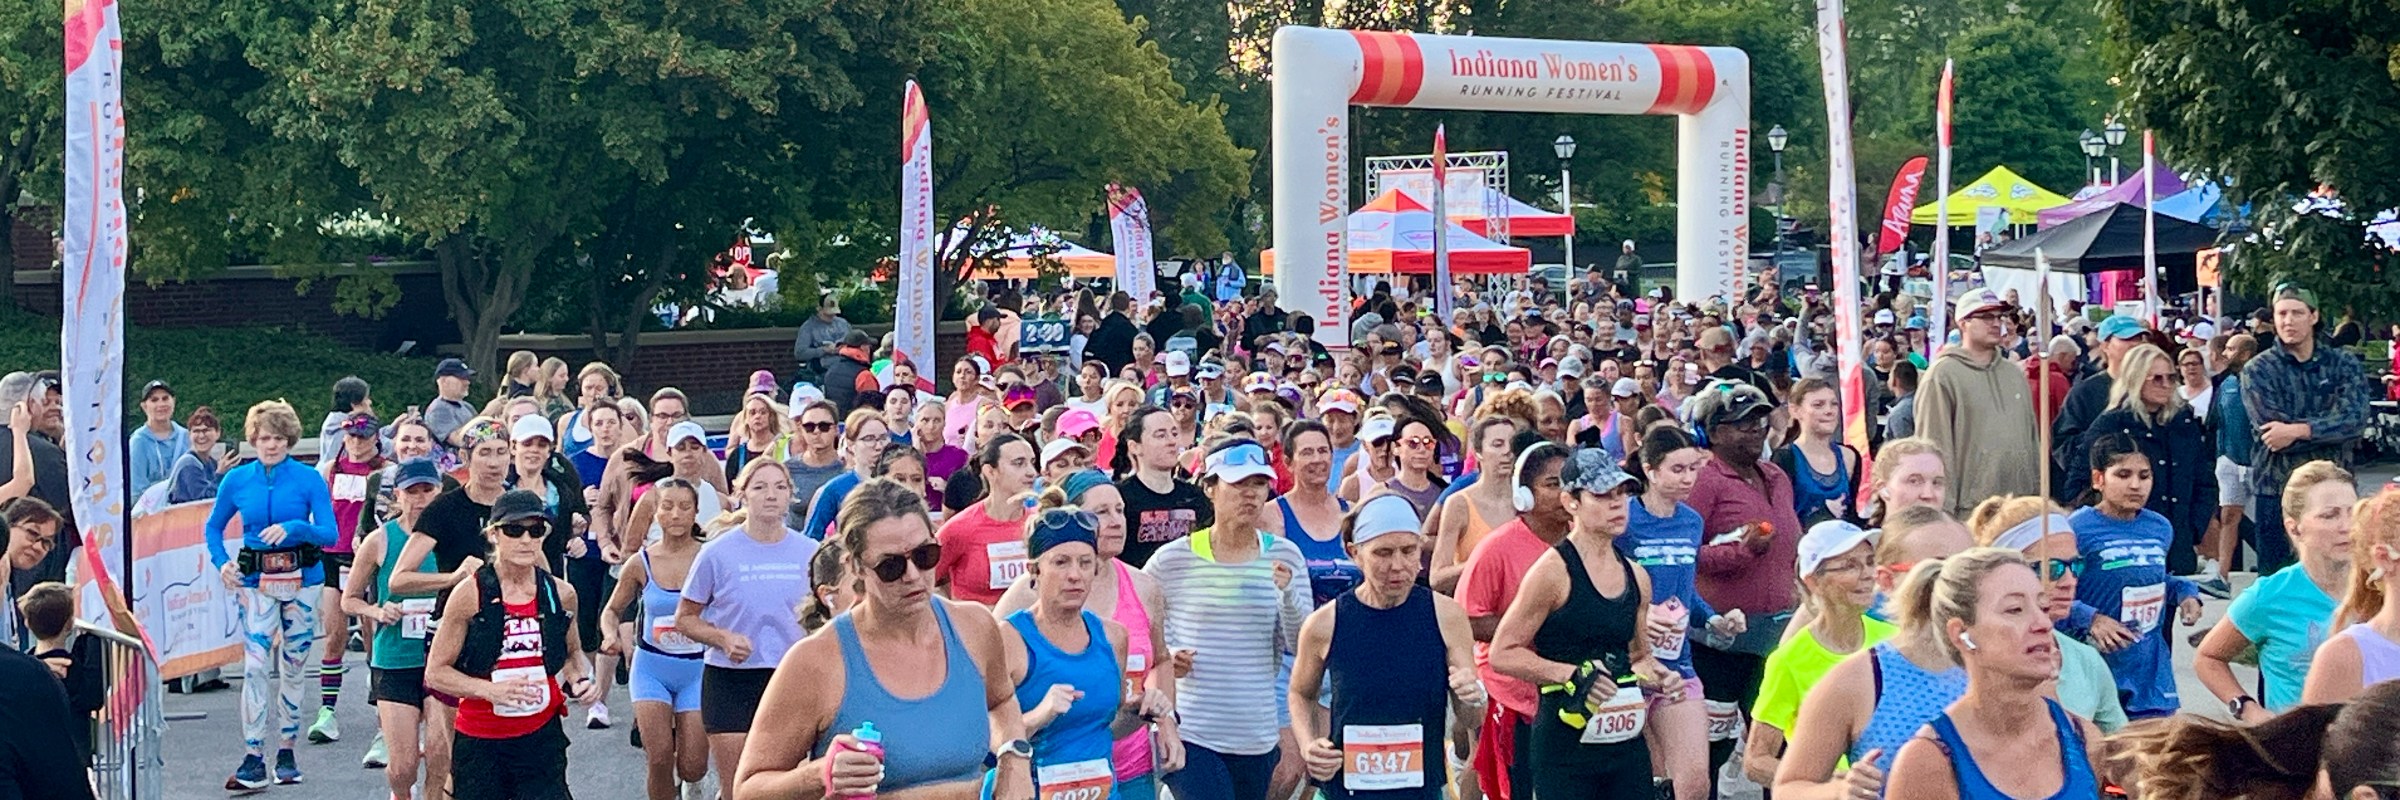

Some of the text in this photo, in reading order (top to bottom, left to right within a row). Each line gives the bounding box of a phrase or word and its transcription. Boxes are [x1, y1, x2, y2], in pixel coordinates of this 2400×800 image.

[1449, 48, 1638, 82] Indiana Women's
[1459, 84, 1621, 100] RUNNING FESTIVAL
[1317, 116, 1340, 327] Indiana Women's
[1719, 141, 1730, 297] RUNNING FESTIVA
[1733, 129, 1748, 305] Indiana Women
[911, 246, 929, 358] Women's
[998, 562, 1025, 580] 101
[1594, 712, 1637, 736] 1306
[1355, 751, 1411, 774] 6347
